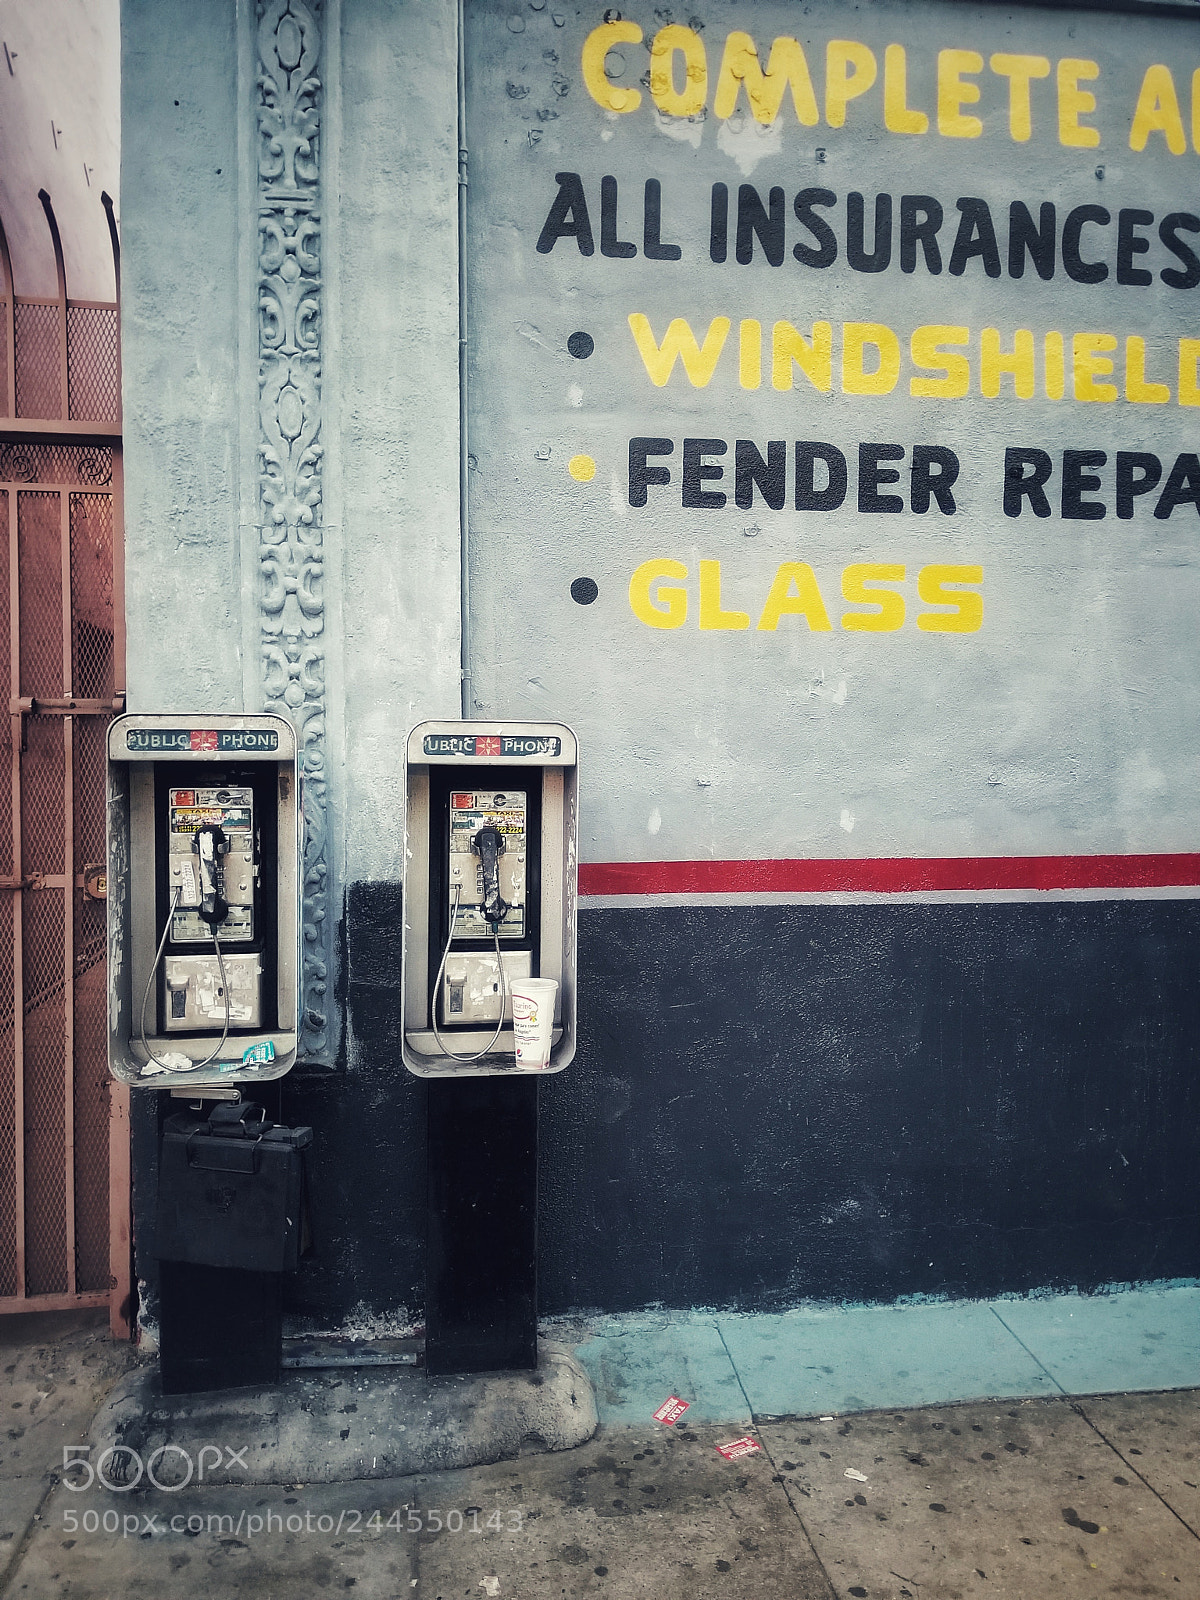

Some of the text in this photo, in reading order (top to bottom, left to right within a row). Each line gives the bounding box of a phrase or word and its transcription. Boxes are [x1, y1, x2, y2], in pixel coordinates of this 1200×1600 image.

[582, 19, 1200, 156] COMPLETE A
[536, 172, 1200, 290] ALL INSURANCES
[629, 437, 1200, 520] FENDER REPA
[629, 559, 984, 633] GLASS
[128, 734, 278, 748] PUBLIC PHONE
[425, 739, 473, 751] UBLIC
[667, 1405, 686, 1422] TAXI
